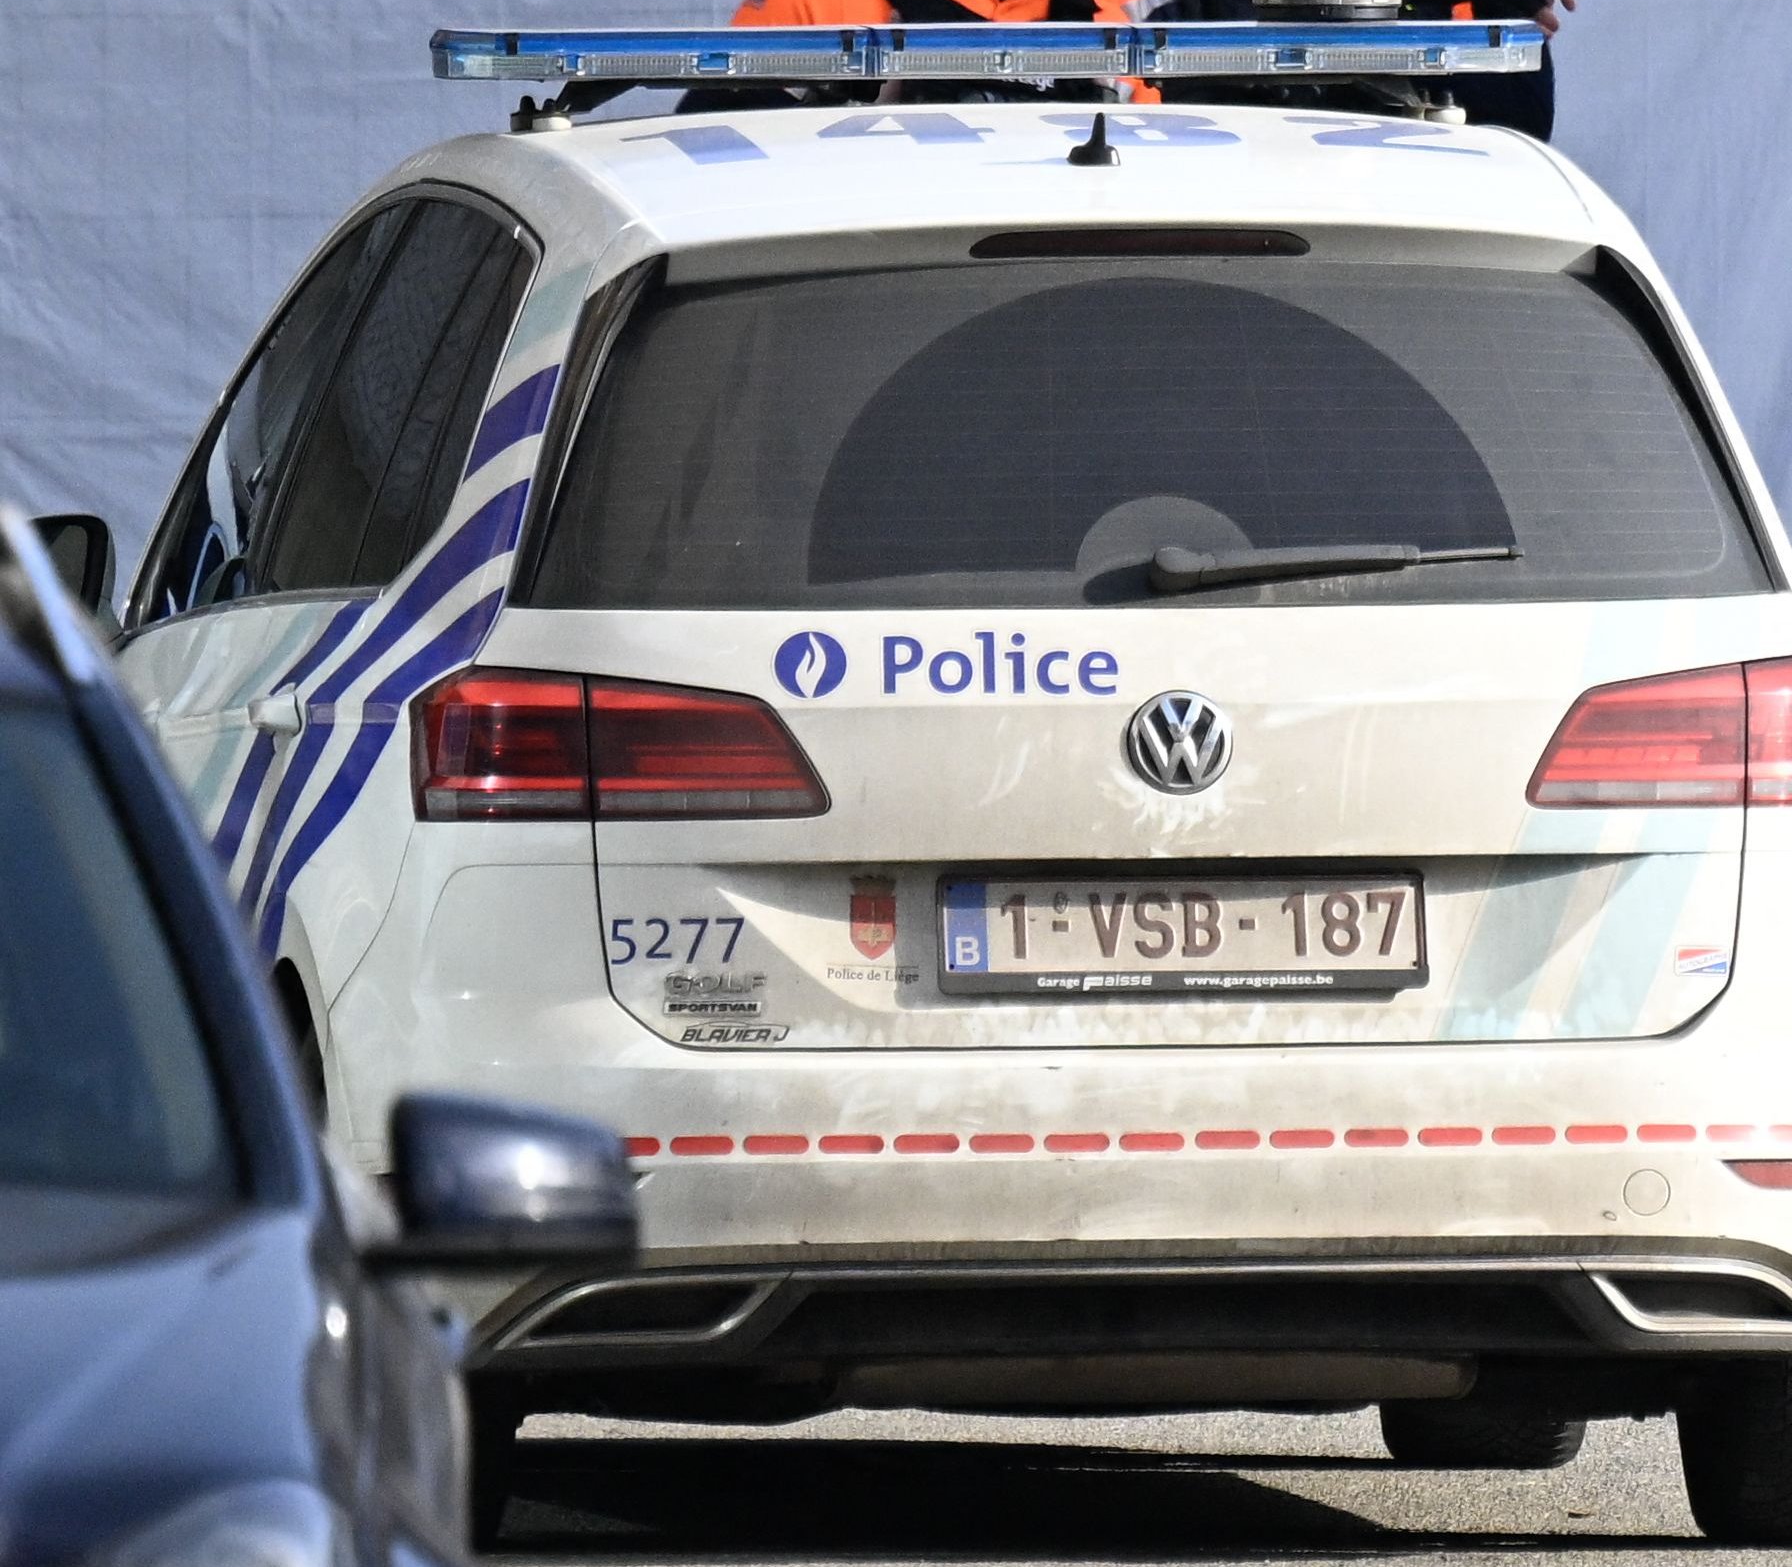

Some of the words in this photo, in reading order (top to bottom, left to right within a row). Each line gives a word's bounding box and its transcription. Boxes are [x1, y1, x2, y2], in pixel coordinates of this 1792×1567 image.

[882, 630, 1119, 695] Police
[610, 917, 745, 965] 5277
[954, 936, 981, 966] B
[665, 971, 768, 995] GOLF
[827, 967, 864, 980] Police
[867, 970, 881, 981] de
[1037, 976, 1081, 990] Garage
[1183, 975, 1335, 988] www.garagepaisse.be
[668, 1003, 758, 1013] SPORTSVAN
[680, 1027, 772, 1043] BLAVIER
